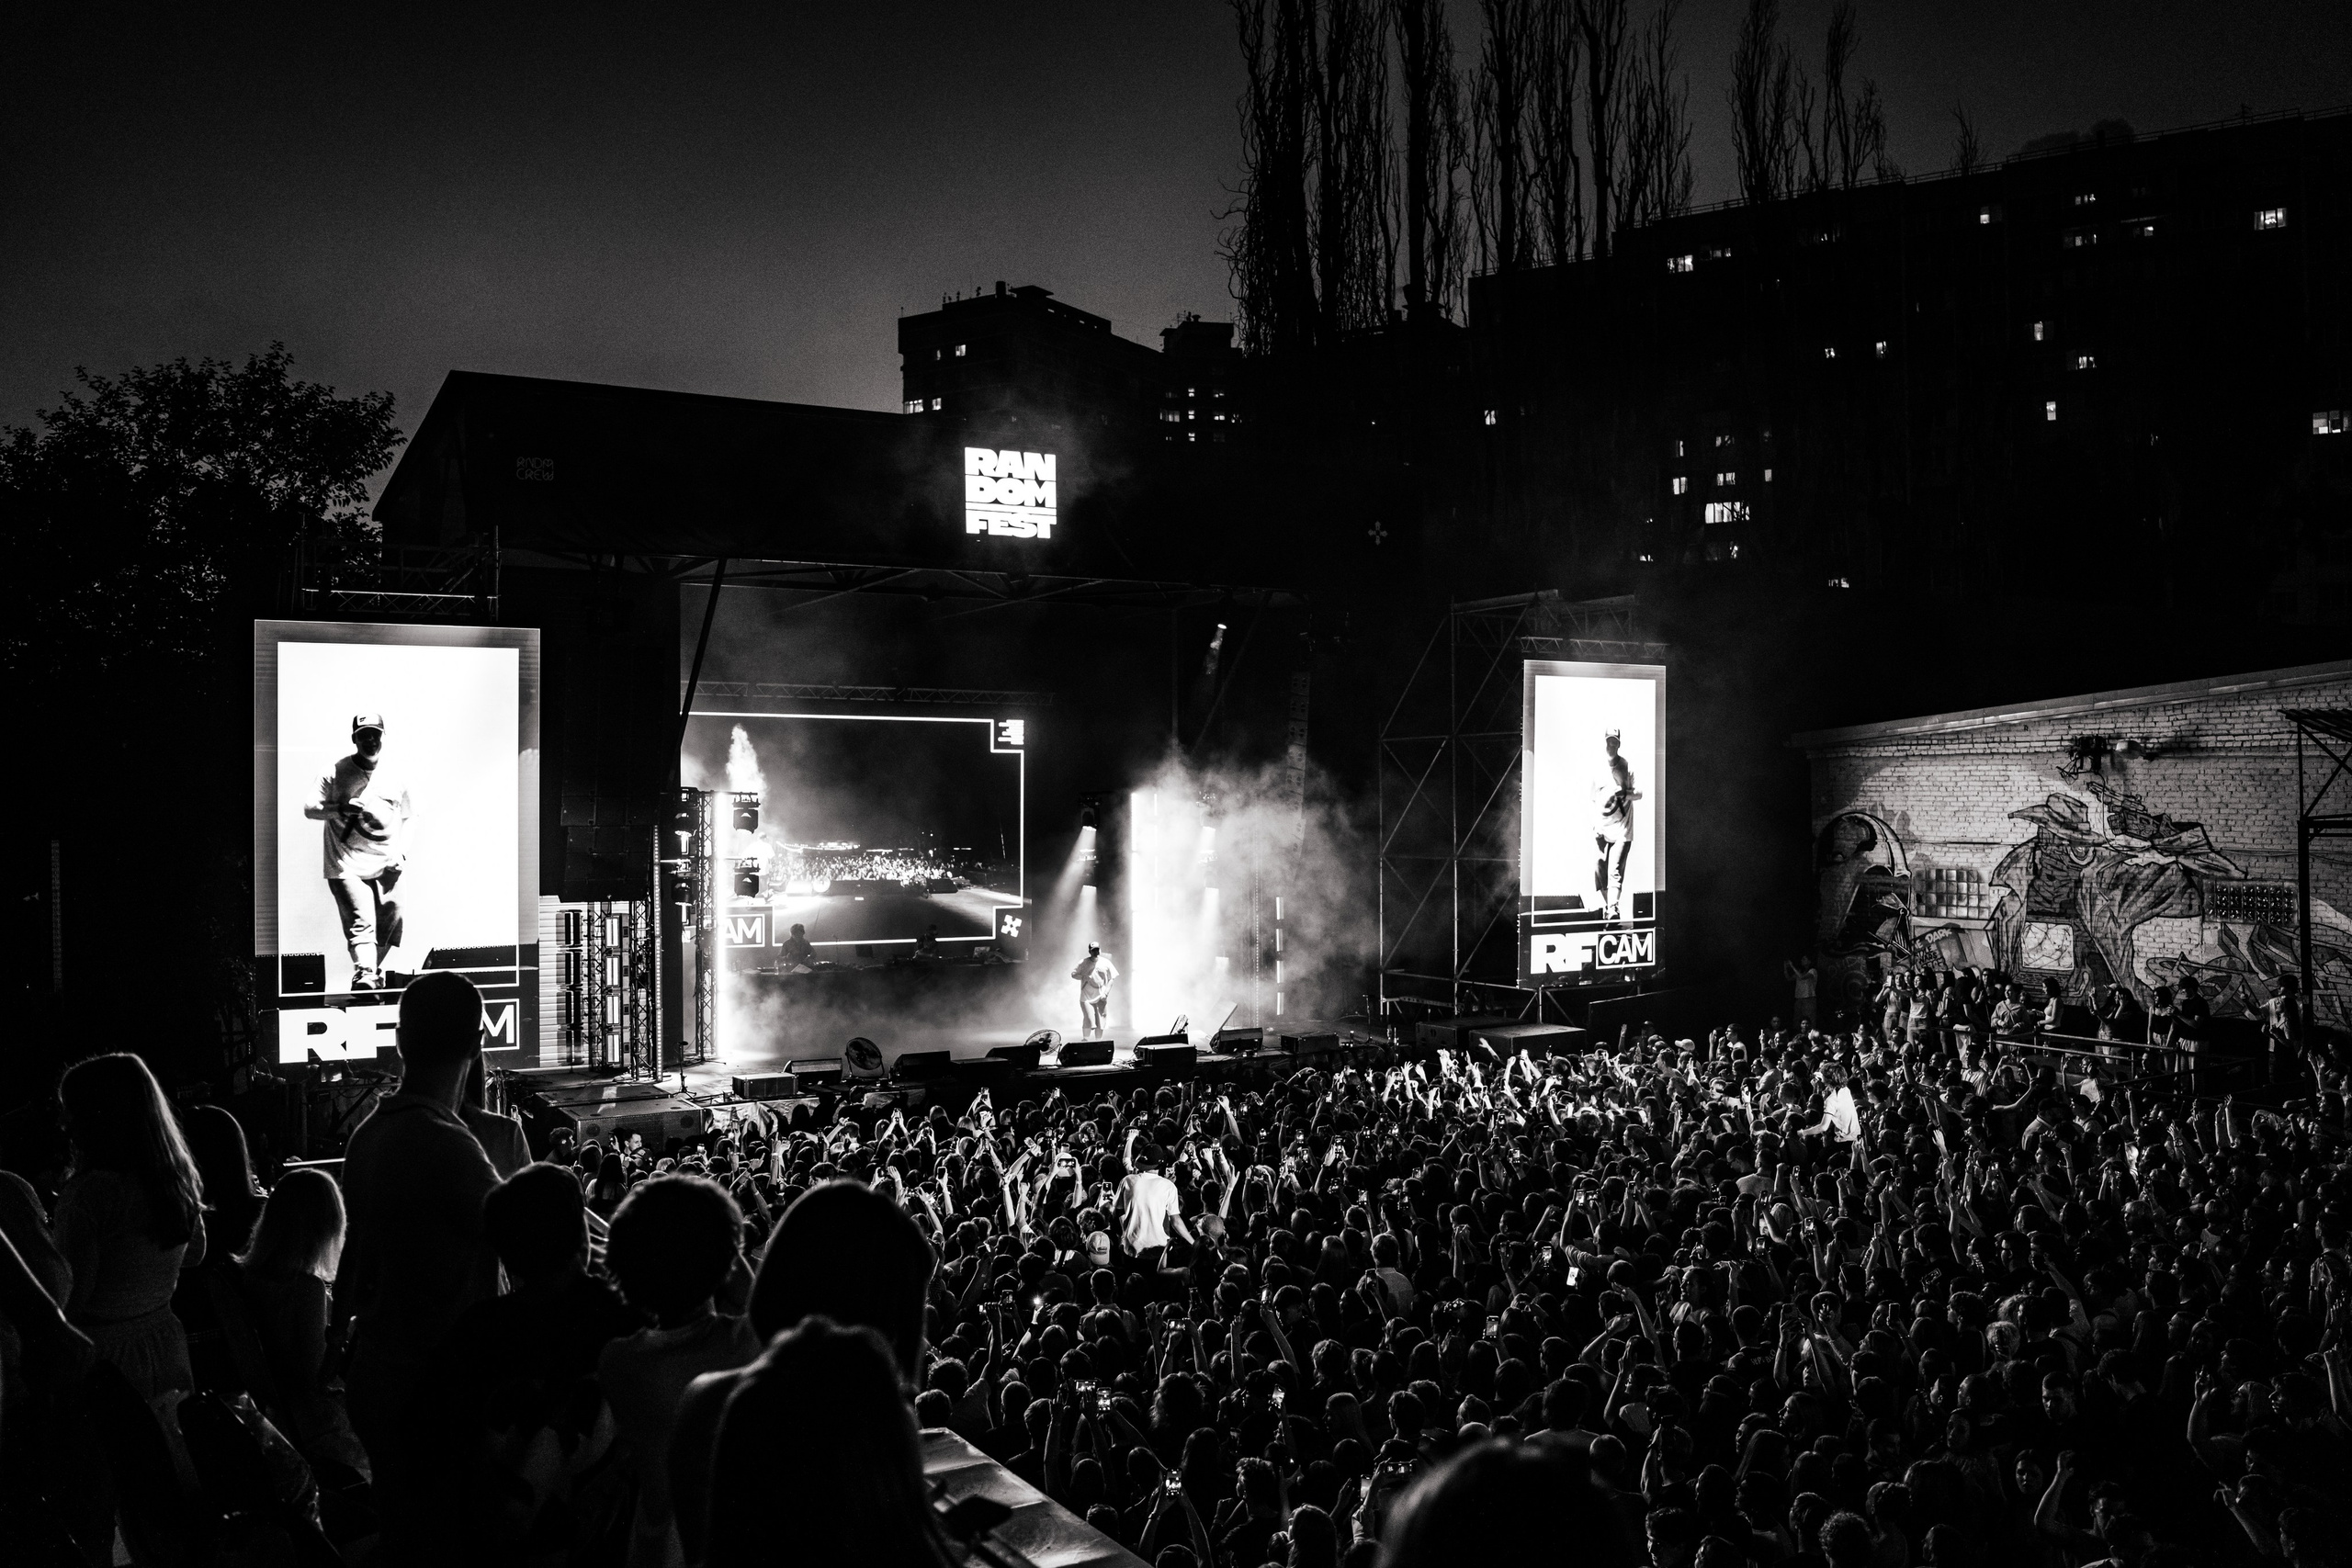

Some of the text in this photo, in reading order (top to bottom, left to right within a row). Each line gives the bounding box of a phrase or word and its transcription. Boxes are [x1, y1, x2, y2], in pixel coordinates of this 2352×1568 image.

[516, 468, 554, 481] CREW
[965, 446, 1057, 482] RAN
[965, 474, 1057, 509] DOM
[966, 509, 1057, 539] FEST
[722, 917, 763, 944] AM
[1925, 928, 1952, 943] DARK
[1599, 931, 1653, 964] CAM
